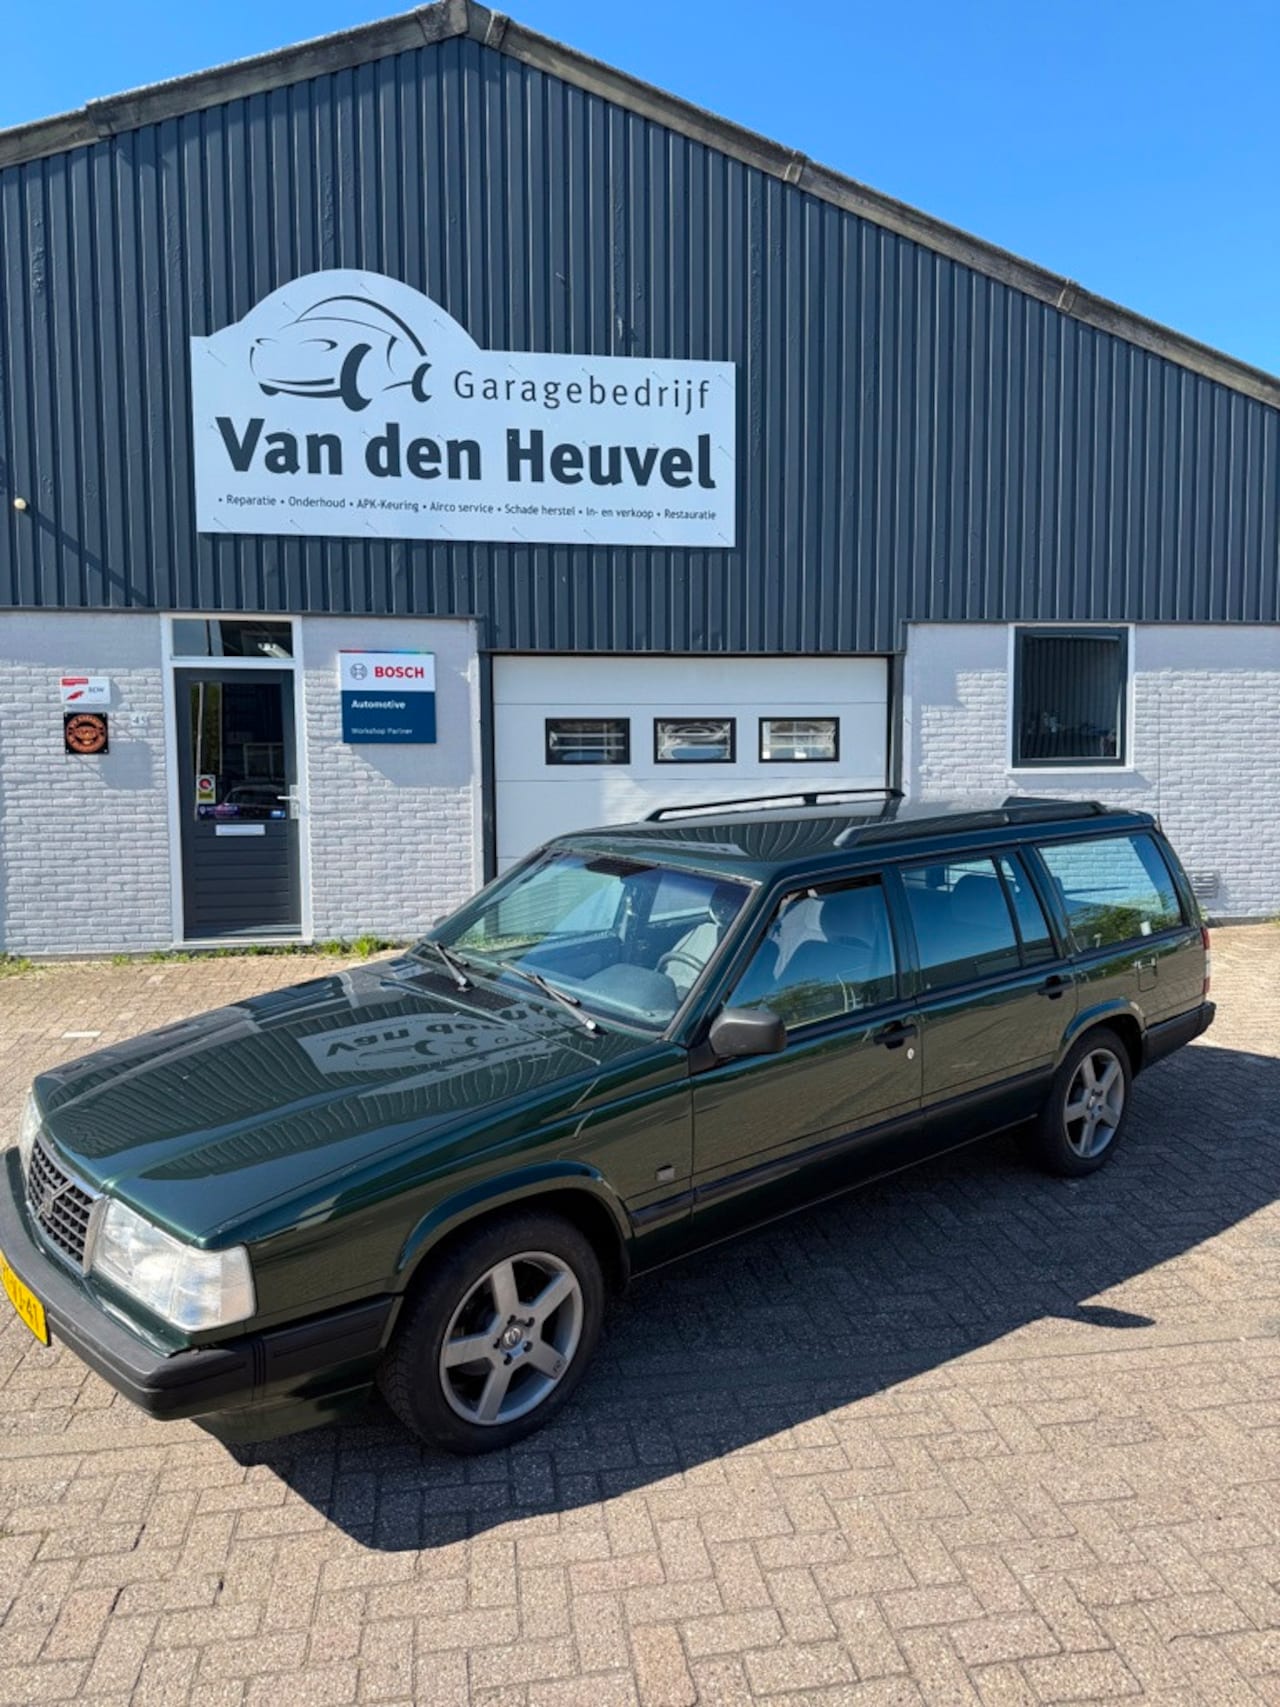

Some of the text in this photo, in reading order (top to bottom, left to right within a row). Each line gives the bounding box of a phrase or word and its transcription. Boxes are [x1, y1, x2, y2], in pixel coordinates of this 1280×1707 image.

[453, 370, 710, 415] Garagebedrijf
[215, 416, 716, 488] Van den Heuvel
[226, 494, 277, 507] Reparatie
[288, 496, 346, 508] Onderhoud
[356, 498, 420, 513] APK-Keuring
[429, 501, 456, 512] Airco
[457, 503, 494, 514] service
[504, 503, 539, 515] Schade
[541, 505, 576, 516] herstel
[601, 508, 614, 517] en
[616, 508, 654, 520] verkoop
[664, 509, 717, 521] Restauratie
[374, 666, 424, 679] BOSCH
[351, 699, 407, 710] Automotive
[351, 727, 413, 736] Workshop Partner
